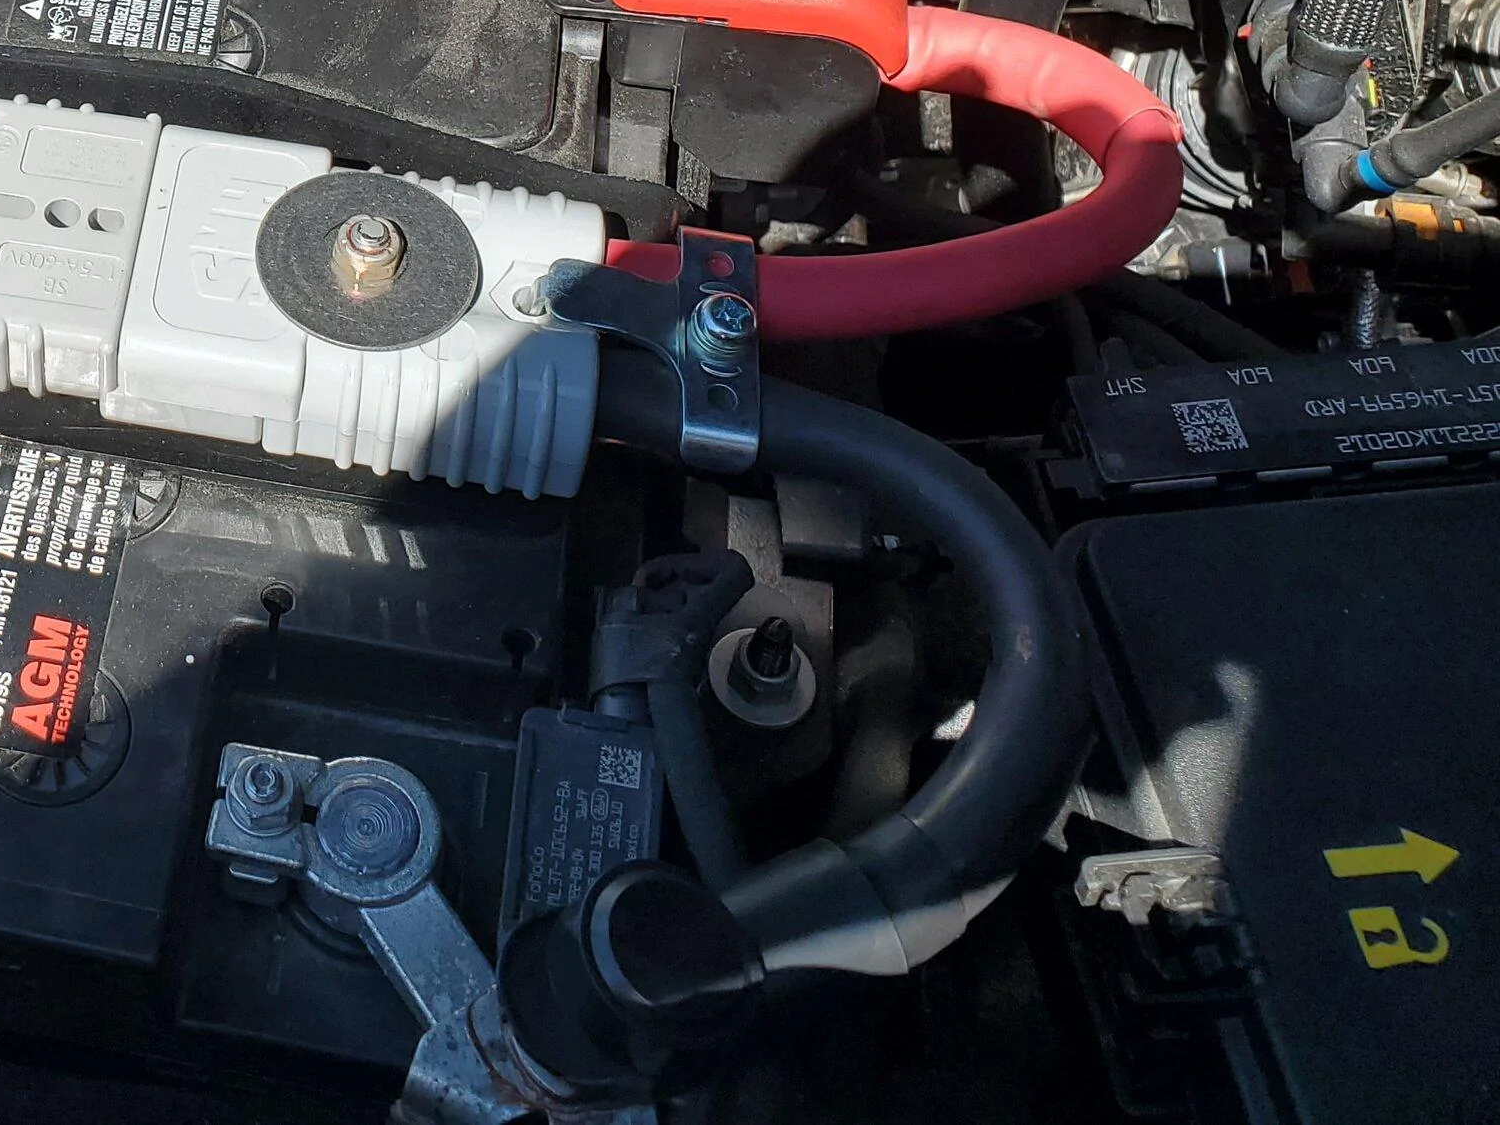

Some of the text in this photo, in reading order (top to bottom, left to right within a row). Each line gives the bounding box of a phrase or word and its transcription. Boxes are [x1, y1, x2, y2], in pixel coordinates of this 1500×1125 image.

[145, 11, 160, 21] OU
[172, 4, 187, 15] OF
[186, 5, 203, 29] HORS
[106, 5, 130, 46] PROTÉGEZ
[169, 14, 185, 32] OUT
[199, 26, 215, 43] PAS
[122, 31, 140, 47] GAZ
[165, 31, 181, 52] KEEP
[181, 29, 198, 53] TENIR
[196, 43, 211, 56] NE
[21, 465, 59, 561] des blessures.
[65, 543, 82, 570] de
[87, 556, 105, 576] de
[10, 614, 72, 740] AGM
[50, 623, 89, 741] TECHNOLOGY
[625, 824, 640, 861] exico
[527, 846, 545, 903] FoMoCo
